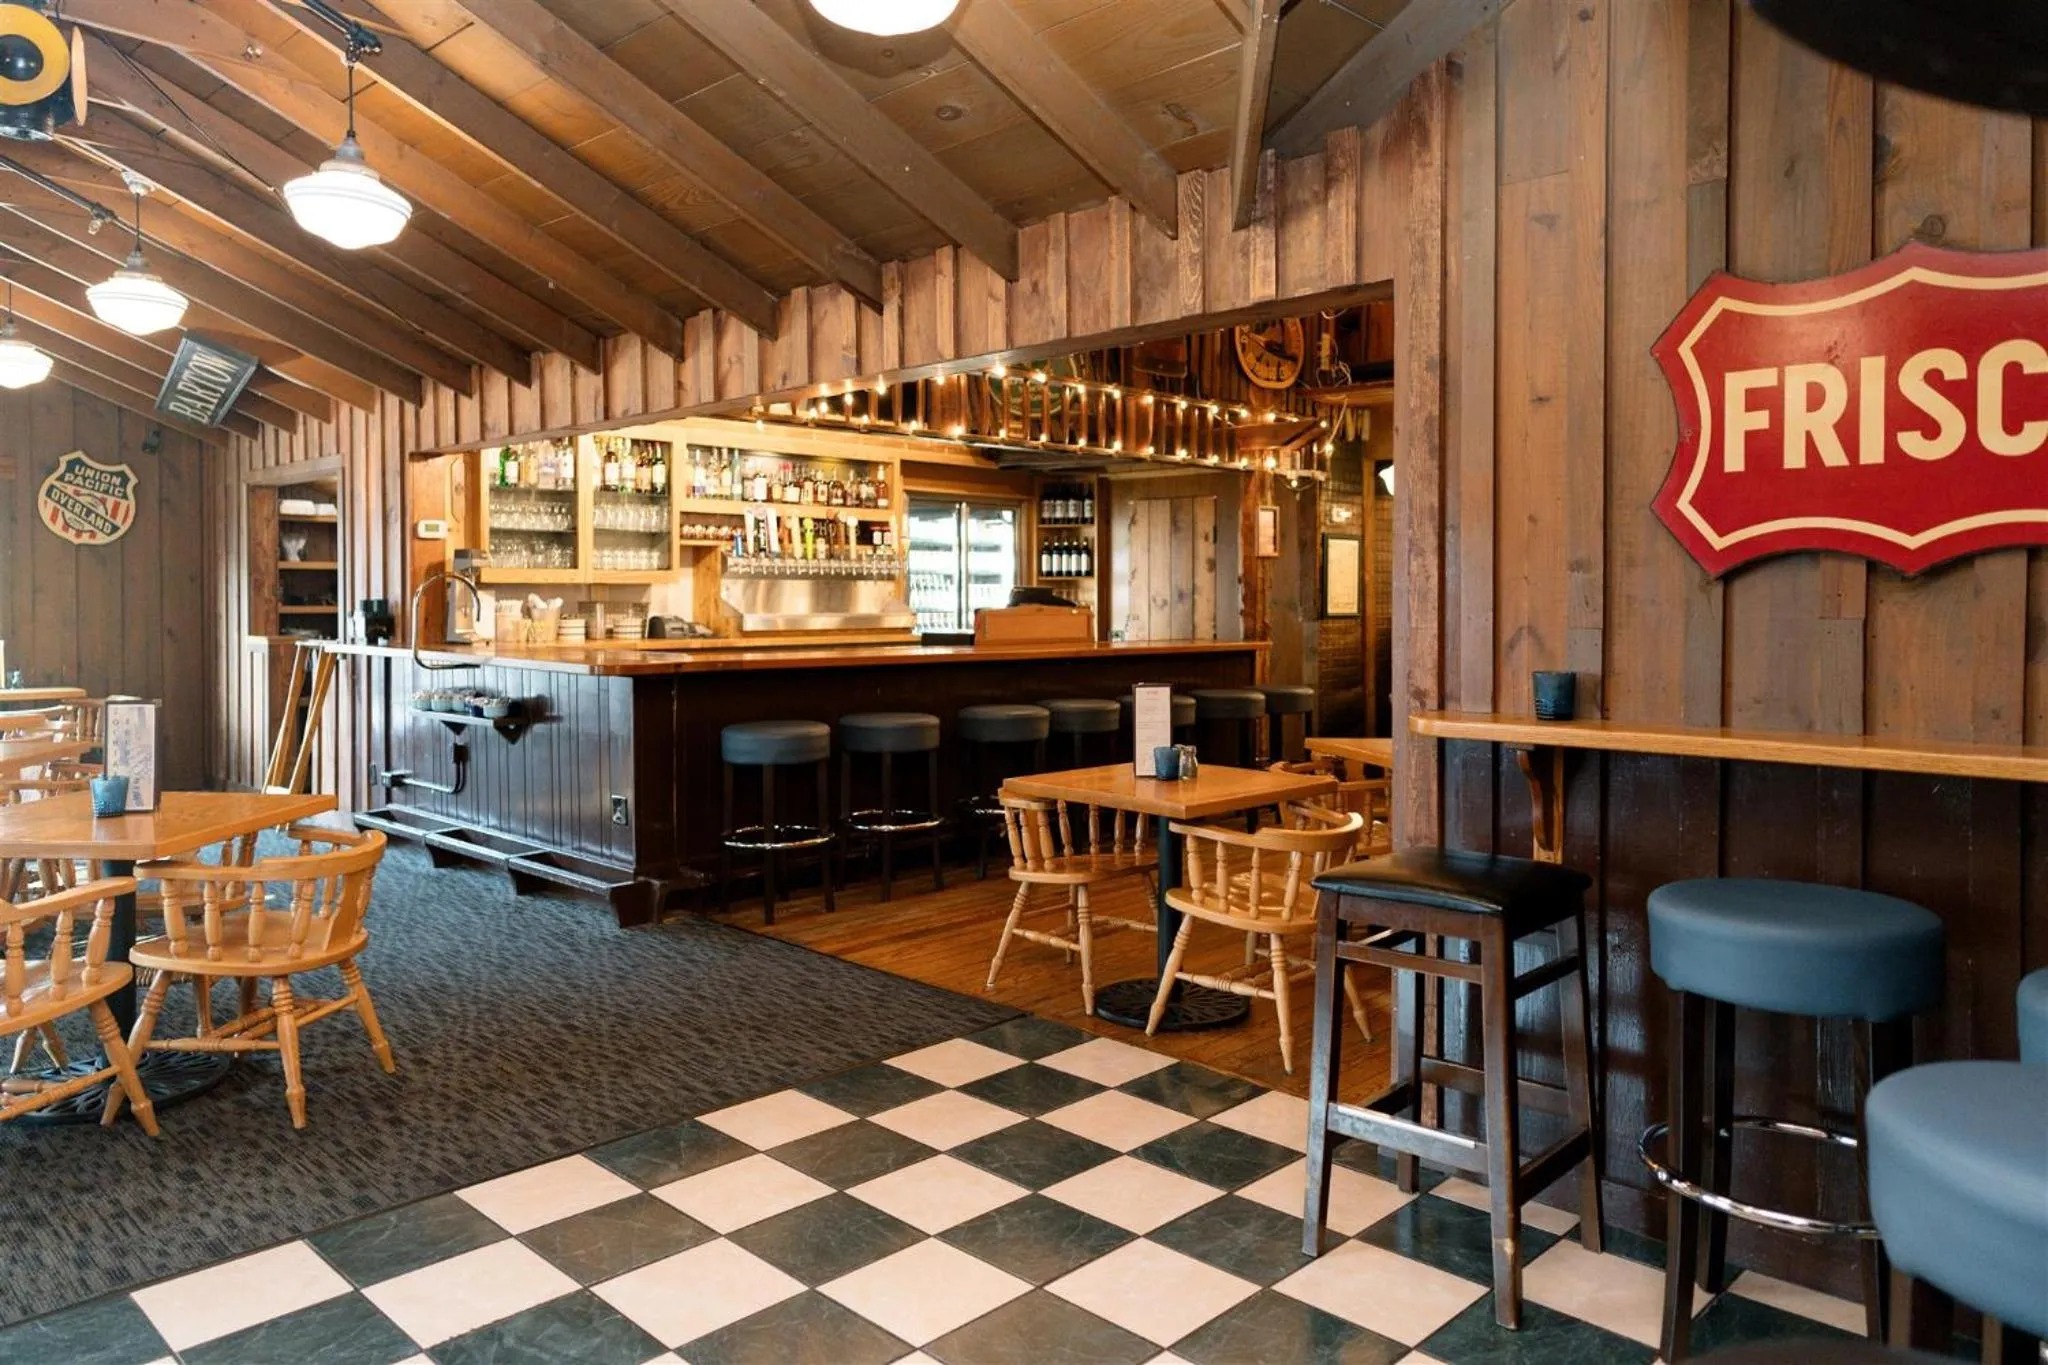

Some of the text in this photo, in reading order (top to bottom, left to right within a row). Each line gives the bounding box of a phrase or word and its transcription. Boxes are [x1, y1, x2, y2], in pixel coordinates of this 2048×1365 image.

[168, 347, 240, 425] BARTON
[64, 472, 126, 498] PACIFIC
[74, 464, 122, 486] UNION
[51, 488, 113, 535] OVERLAND
